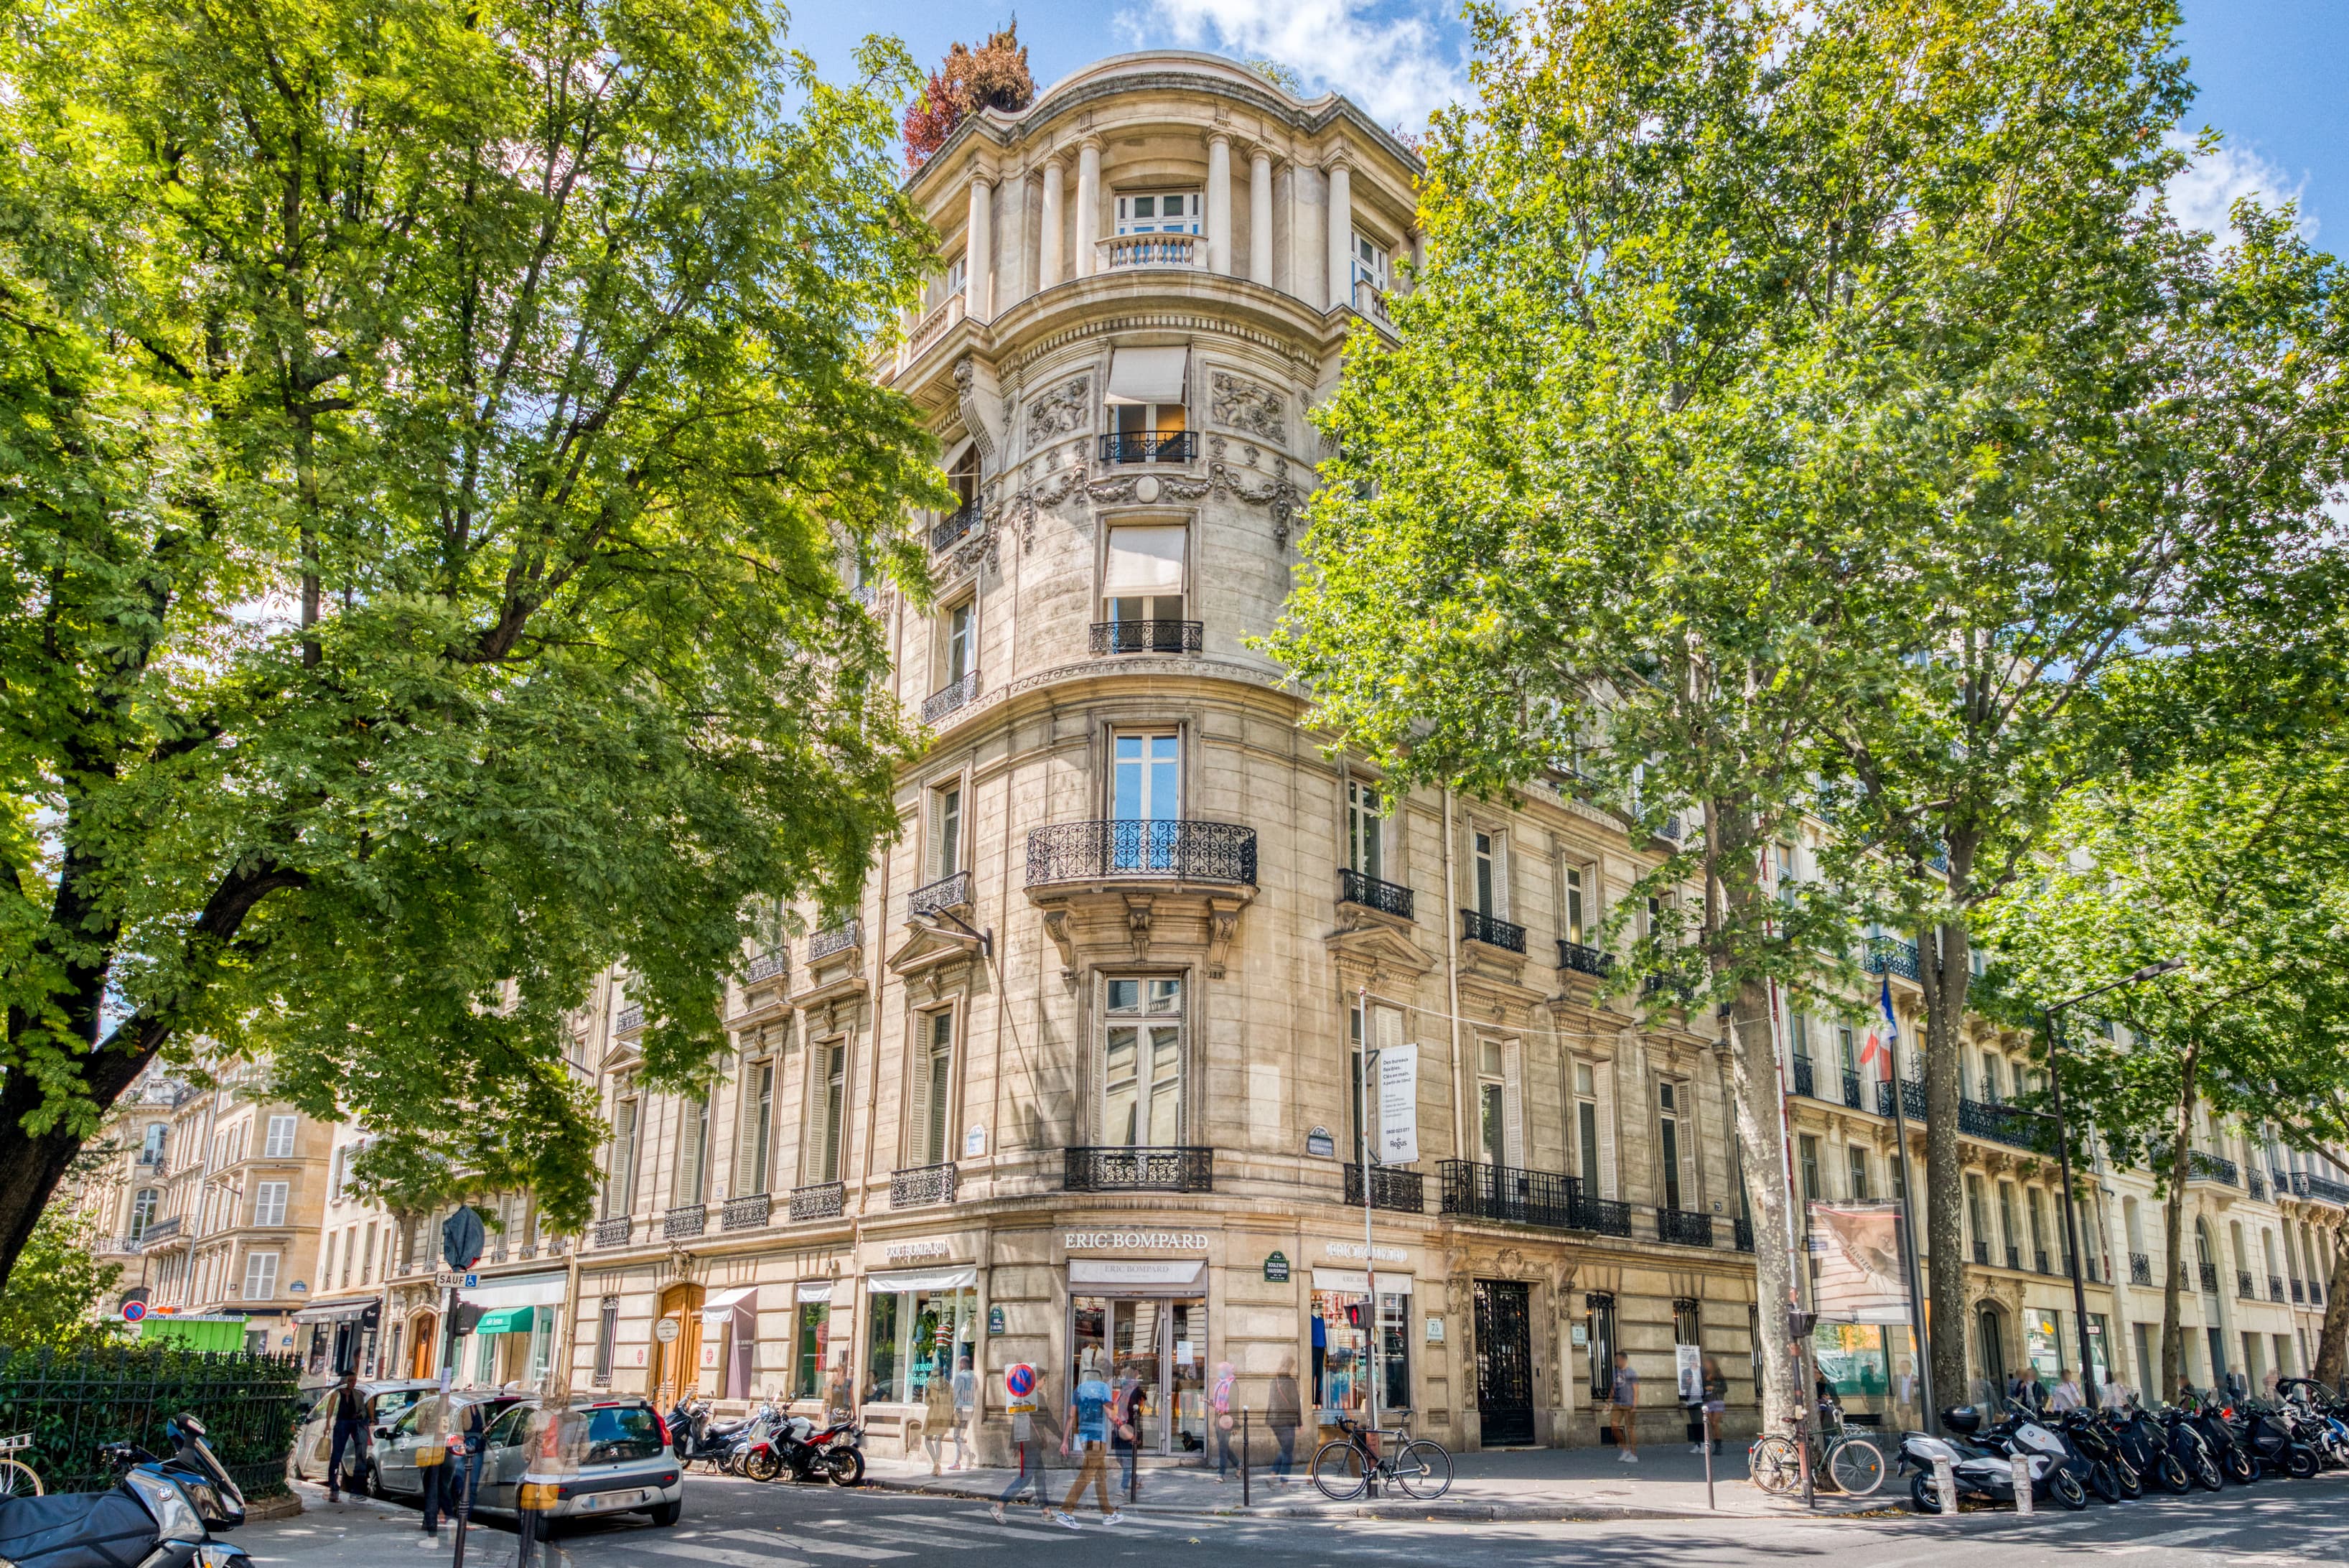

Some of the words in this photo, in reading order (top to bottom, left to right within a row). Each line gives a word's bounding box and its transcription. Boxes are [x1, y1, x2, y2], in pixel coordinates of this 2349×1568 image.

[1390, 1139, 1407, 1149] Regus
[1065, 1233, 1108, 1249] ERIC
[1112, 1233, 1209, 1249] BOMPARD
[885, 1245, 904, 1257] ERIC
[905, 1241, 948, 1256] BOMPARD
[1327, 1242, 1355, 1257] ERIC
[439, 1275, 464, 1284] SAUF
